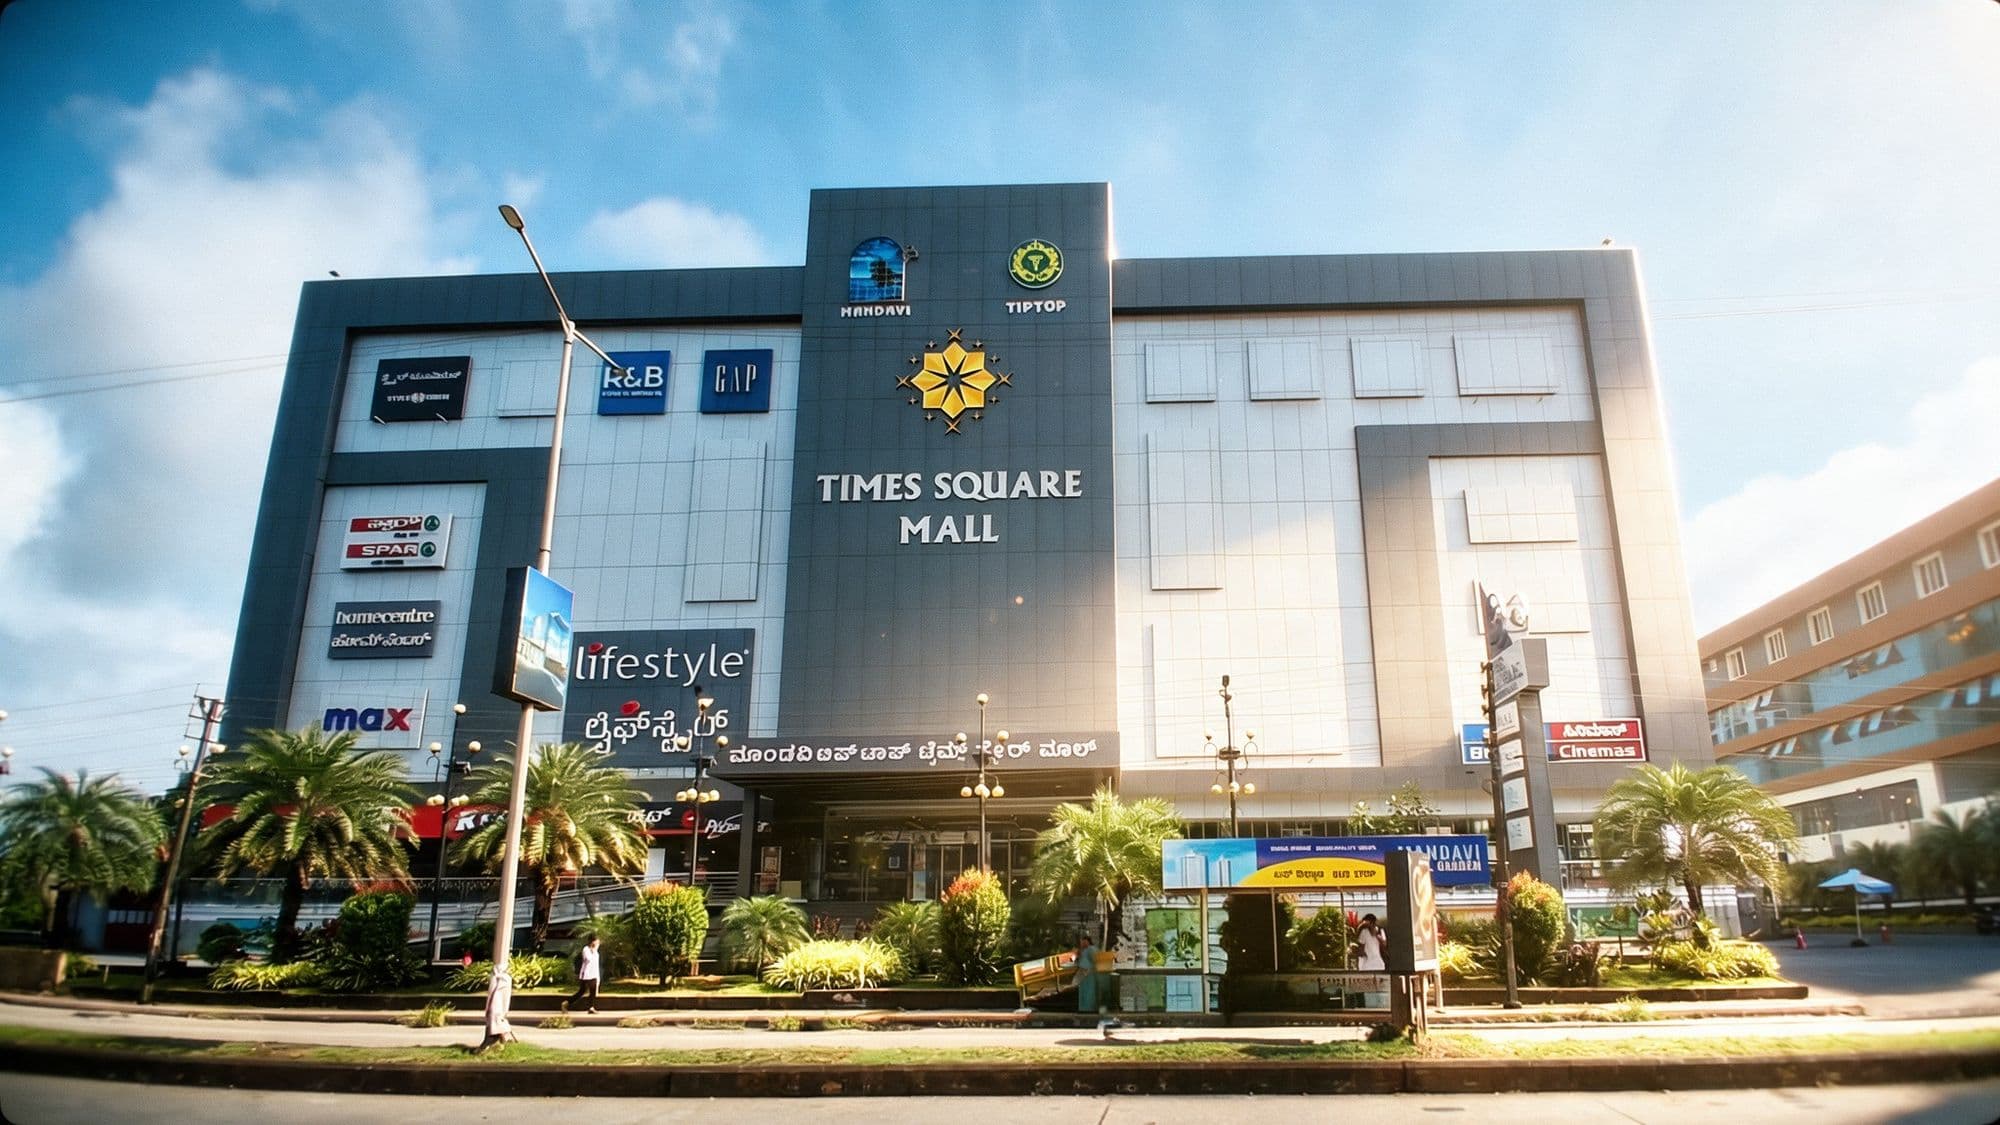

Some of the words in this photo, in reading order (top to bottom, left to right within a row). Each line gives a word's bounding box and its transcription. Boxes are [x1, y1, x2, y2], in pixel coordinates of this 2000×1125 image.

[1005, 299, 1066, 314] TIPTOP
[603, 366, 664, 388] R&B
[715, 364, 757, 392] GAP
[817, 473, 922, 501] TIMES
[934, 470, 1083, 502] SQUARE
[900, 514, 1000, 544] MALL
[361, 545, 418, 556] SPAR
[575, 642, 744, 687] lifestyle
[323, 708, 413, 731] max
[1559, 744, 1636, 758] Cinemas
[1398, 844, 1480, 860] NDAVI
